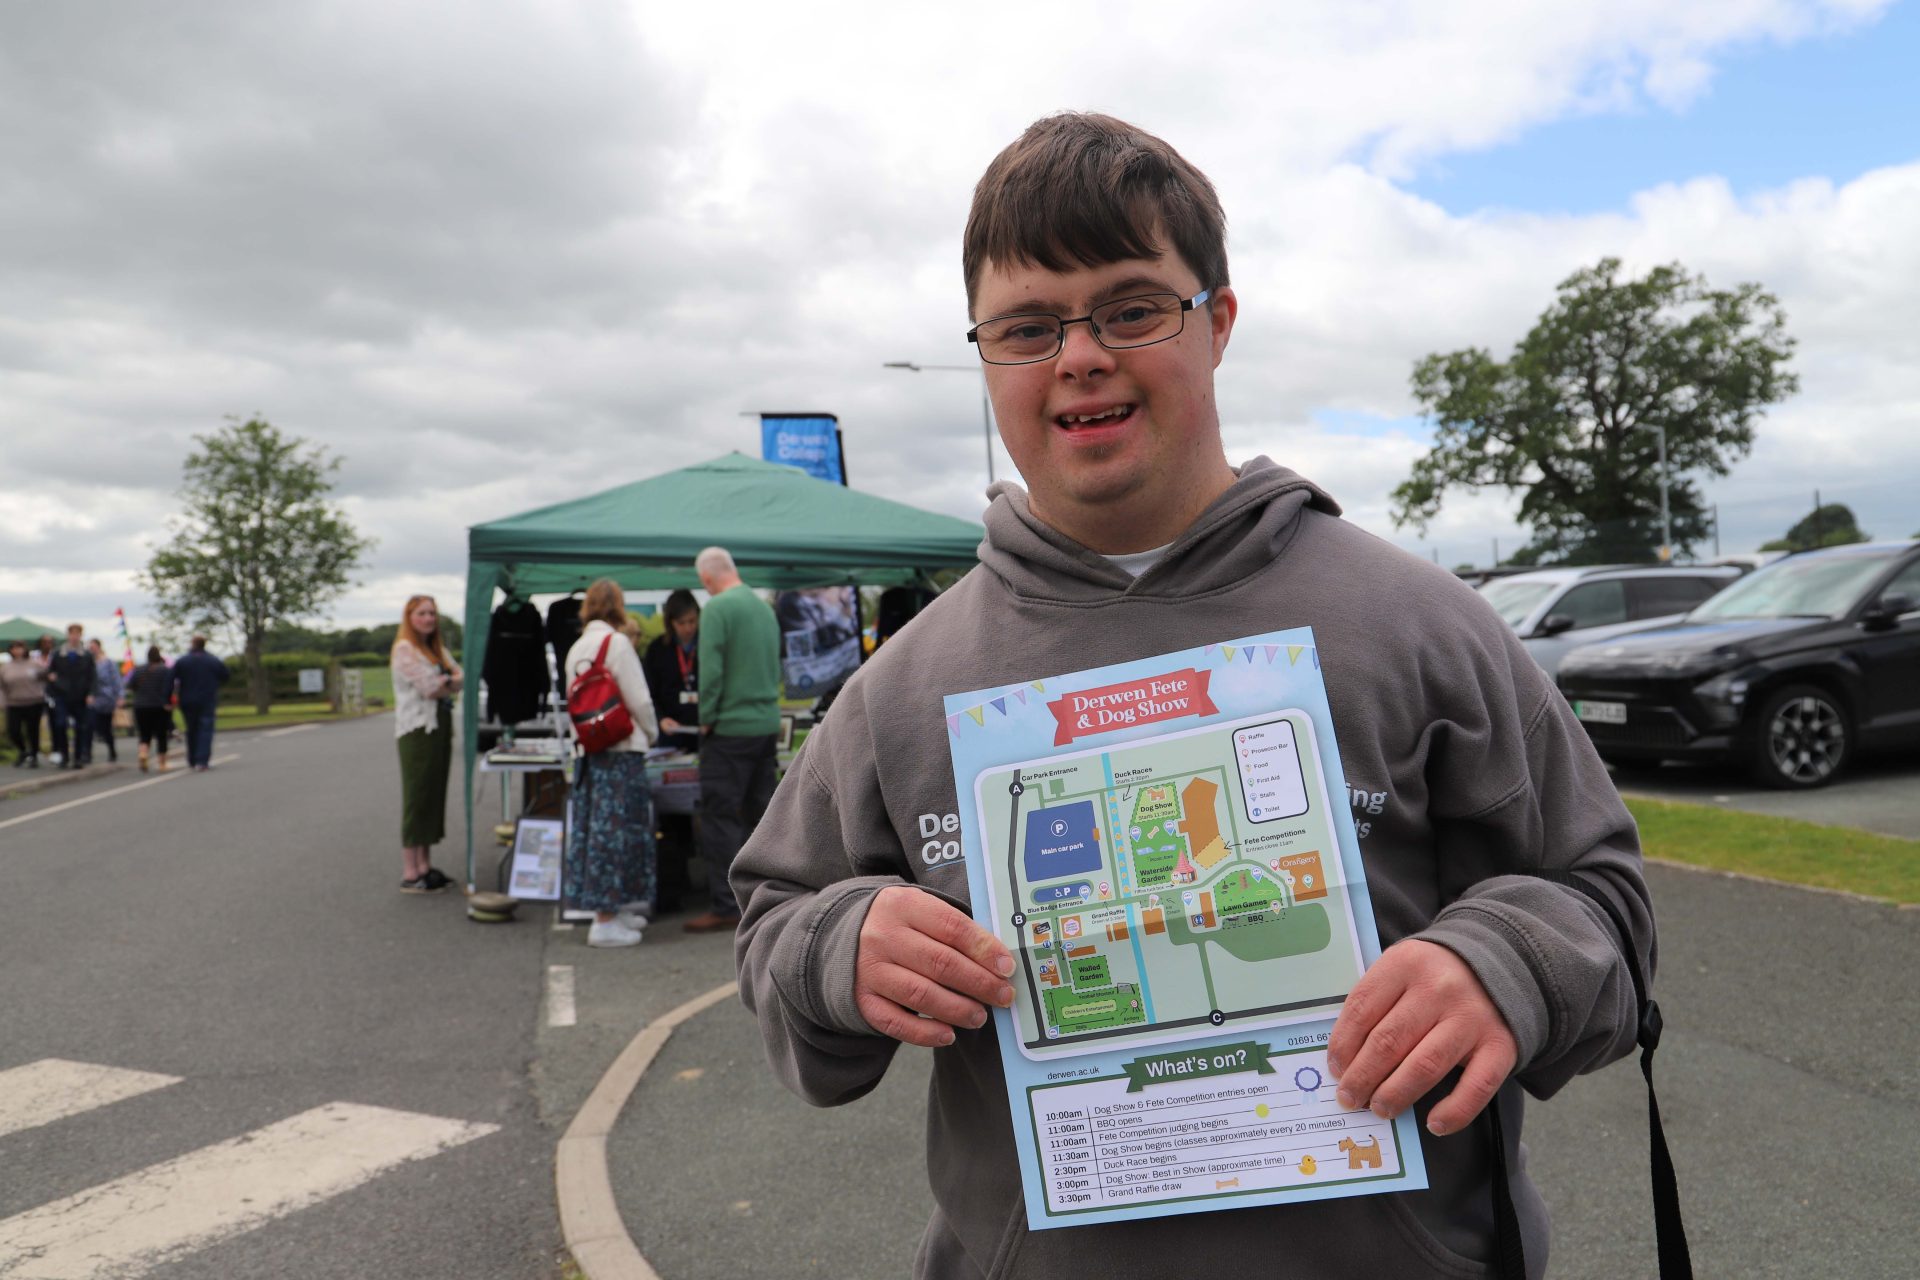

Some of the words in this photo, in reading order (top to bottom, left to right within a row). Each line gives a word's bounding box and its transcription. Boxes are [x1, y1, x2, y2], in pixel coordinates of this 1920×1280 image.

[1073, 688, 1147, 713] Derwen
[1149, 679, 1188, 698] Fete
[1077, 713, 1095, 729] &
[1098, 707, 1136, 726] Dog
[1138, 697, 1190, 717] Show
[1251, 745, 1278, 754] Prosecco
[1021, 774, 1033, 782] Car
[1033, 771, 1049, 780] Park
[1049, 766, 1079, 777] Entrance
[1114, 770, 1133, 779] Duck
[1133, 766, 1153, 776] Races
[1256, 776, 1270, 784] First
[1012, 784, 1022, 794] A
[1140, 803, 1155, 813] Dog
[1154, 801, 1174, 810] Show
[1138, 813, 1154, 821] Starts
[1244, 837, 1260, 846] Fete
[1260, 828, 1307, 842] Competitions
[1041, 846, 1058, 856] Main
[1058, 845, 1069, 853] car
[1068, 842, 1085, 852] park
[1282, 855, 1317, 868] Orangery
[1140, 864, 1174, 876] Waterside
[1141, 874, 1166, 884] Garden
[1063, 887, 1071, 896] P
[1027, 906, 1040, 914] Blue
[1040, 903, 1058, 913] Badge
[1058, 900, 1084, 909] Entrance
[1223, 903, 1243, 912] Lawn
[1243, 899, 1268, 909] Games
[1014, 915, 1023, 924] B
[1091, 911, 1108, 920] Grand
[1108, 908, 1126, 917] Raffle
[1247, 914, 1264, 923] BBQ
[1078, 963, 1101, 973] Walled
[1079, 973, 1104, 982] Garden
[1212, 1013, 1222, 1023] C
[1288, 1035, 1315, 1047] 01691
[1145, 1056, 1209, 1079] What's
[1213, 1049, 1247, 1069] on?
[1047, 1065, 1100, 1081] derwen.ac.uk
[1046, 1109, 1083, 1122] 10:00am
[1094, 1105, 1112, 1116] Dog
[1113, 1101, 1136, 1113] Show
[1137, 1101, 1145, 1109] &
[1145, 1098, 1165, 1108] Fete
[1166, 1090, 1216, 1105] Competition
[1217, 1087, 1246, 1099] entries
[1247, 1085, 1269, 1096] open
[1048, 1123, 1085, 1136] 11:00am
[1096, 1118, 1117, 1129] BBQ
[1118, 1115, 1143, 1128] opens
[1050, 1137, 1088, 1149] 11:00am
[1099, 1131, 1118, 1142] Fete
[1119, 1125, 1168, 1140] Competition
[1169, 1121, 1200, 1136] judging
[1201, 1117, 1229, 1130] begins
[1052, 1150, 1090, 1163] 11:30am
[1101, 1146, 1119, 1157] Dog
[1119, 1142, 1144, 1154] Show
[1144, 1137, 1173, 1151] begins
[1174, 1134, 1208, 1148] (classes
[1209, 1128, 1268, 1143] approximately
[1269, 1124, 1294, 1136] every
[1294, 1121, 1307, 1132] 20
[1307, 1117, 1346, 1130] minutes)
[1054, 1164, 1088, 1177] 2:30pm
[1103, 1159, 1125, 1171] Duck
[1126, 1156, 1149, 1167] Race
[1149, 1152, 1178, 1165] begins
[1056, 1178, 1089, 1191] 3:00pm
[1105, 1174, 1124, 1186] Dog
[1124, 1171, 1151, 1183] Show:
[1151, 1168, 1172, 1179] Best
[1172, 1168, 1182, 1176] in
[1182, 1163, 1207, 1175] Show
[1207, 1157, 1263, 1173] (approximate
[1263, 1155, 1287, 1167] time)
[1058, 1192, 1092, 1205] 3:30pm
[1107, 1186, 1134, 1199] Grand
[1135, 1182, 1160, 1195] Raffle
[1160, 1180, 1183, 1192] draw
